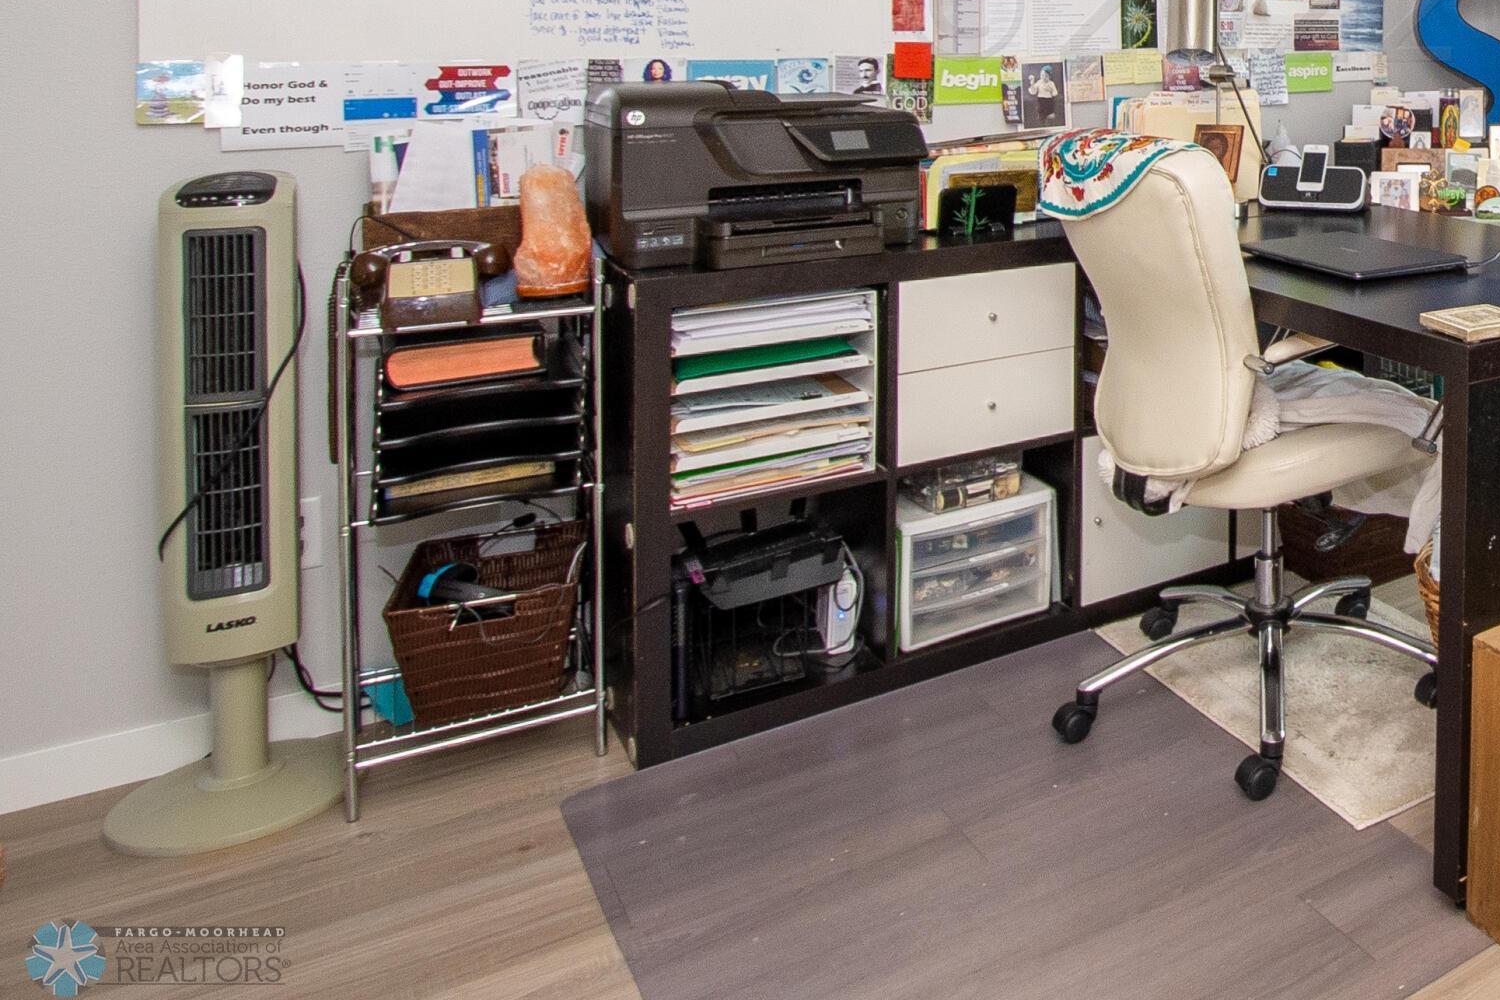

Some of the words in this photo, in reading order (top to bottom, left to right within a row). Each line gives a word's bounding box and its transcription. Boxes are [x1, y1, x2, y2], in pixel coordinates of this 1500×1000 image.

[1288, 63, 1328, 80] aspire
[243, 82, 284, 91] Honor
[288, 80, 315, 89] God
[319, 80, 328, 88] &
[941, 68, 998, 91] begin
[241, 97, 260, 106] Do
[263, 96, 284, 106] my
[288, 95, 316, 104] best
[893, 97, 928, 111] GOD
[242, 126, 276, 135] Even
[279, 123, 329, 134] though
[205, 615, 256, 633] LASKO
